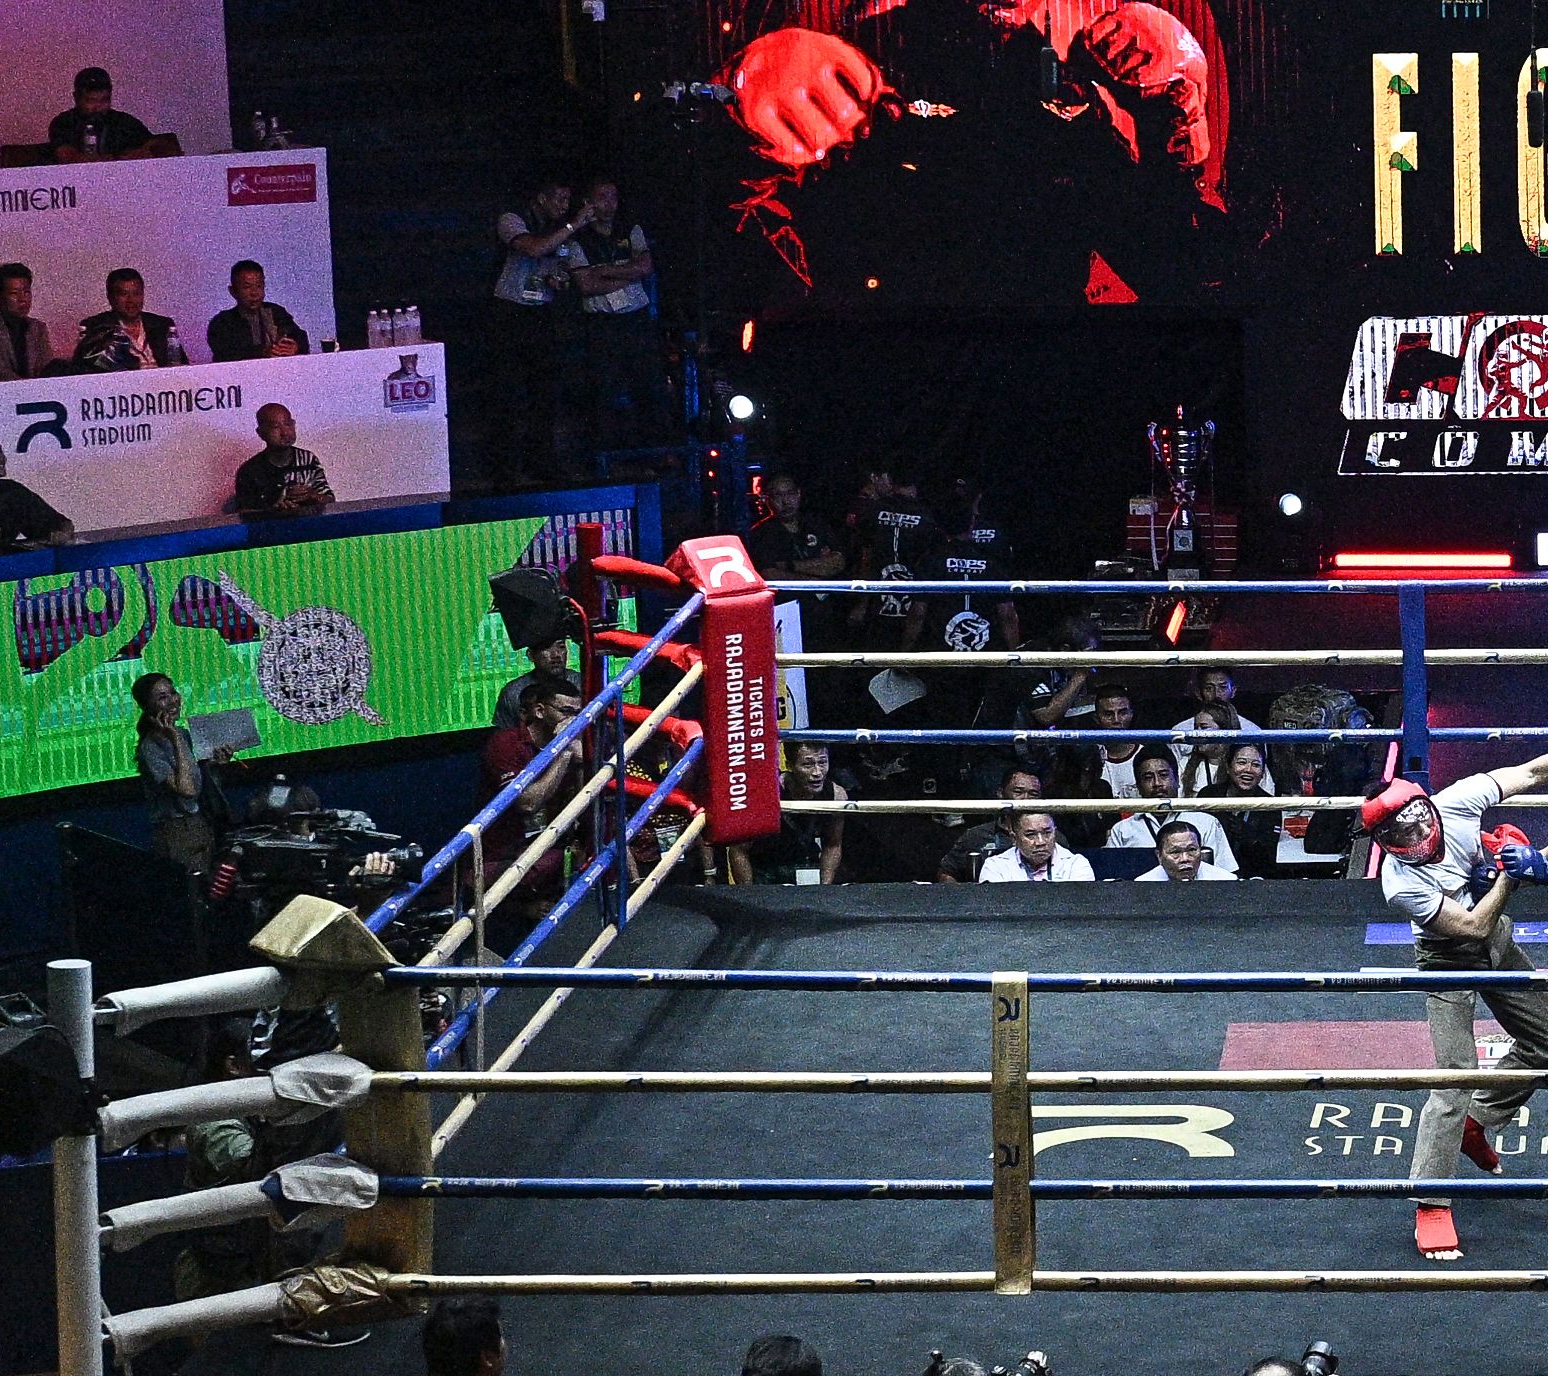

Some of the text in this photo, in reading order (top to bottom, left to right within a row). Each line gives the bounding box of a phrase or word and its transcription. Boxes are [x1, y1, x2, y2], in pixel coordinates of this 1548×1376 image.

[81, 385, 242, 421] RAJADAMNERN
[389, 380, 430, 401] LEO
[82, 423, 152, 447] STADIUM
[725, 633, 748, 812] RAJADAMNERN.COM
[748, 676, 765, 760] TICKETS AT
